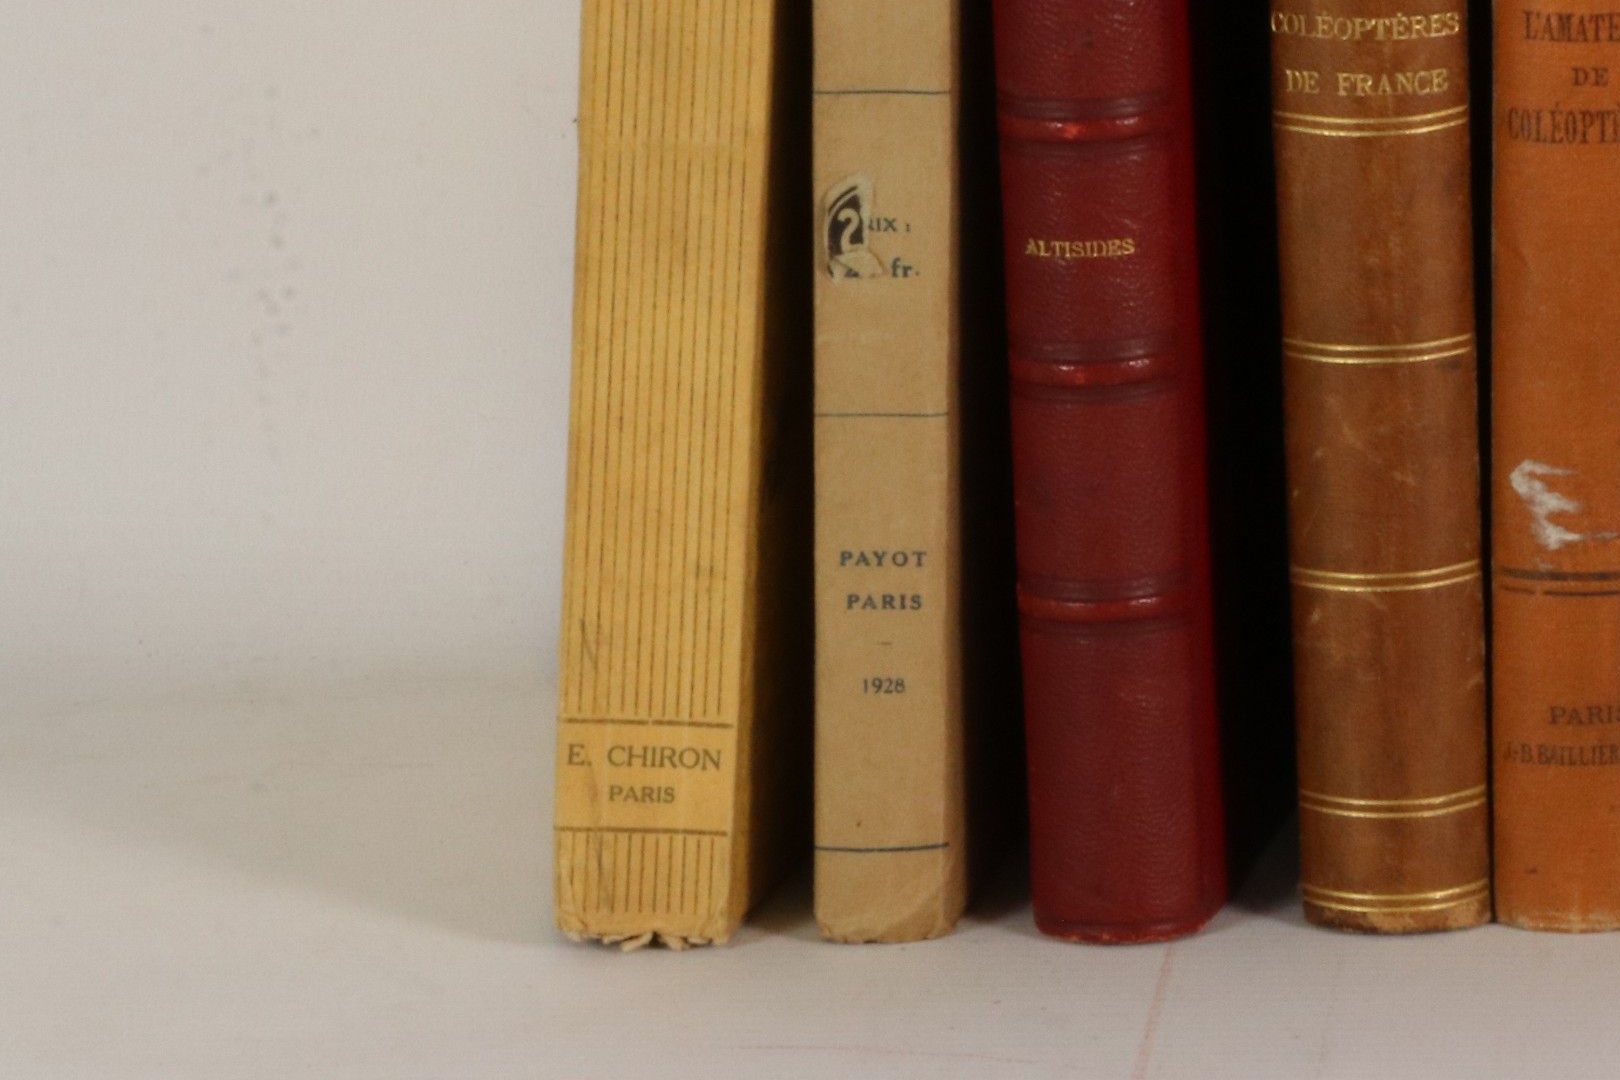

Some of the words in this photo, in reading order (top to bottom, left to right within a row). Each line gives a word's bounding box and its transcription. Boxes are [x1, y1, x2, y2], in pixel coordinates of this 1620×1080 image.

[1285, 69, 1320, 94] DE
[1337, 69, 1448, 96] FRANCE
[1571, 67, 1609, 88] DE
[1025, 237, 1136, 258] ALTISIDES
[840, 551, 927, 567] PAYOT
[847, 594, 922, 610] PARIS
[863, 677, 905, 694] 1928
[568, 744, 591, 767] E.
[607, 745, 721, 771] CHIRON
[608, 785, 676, 804] PARIS
